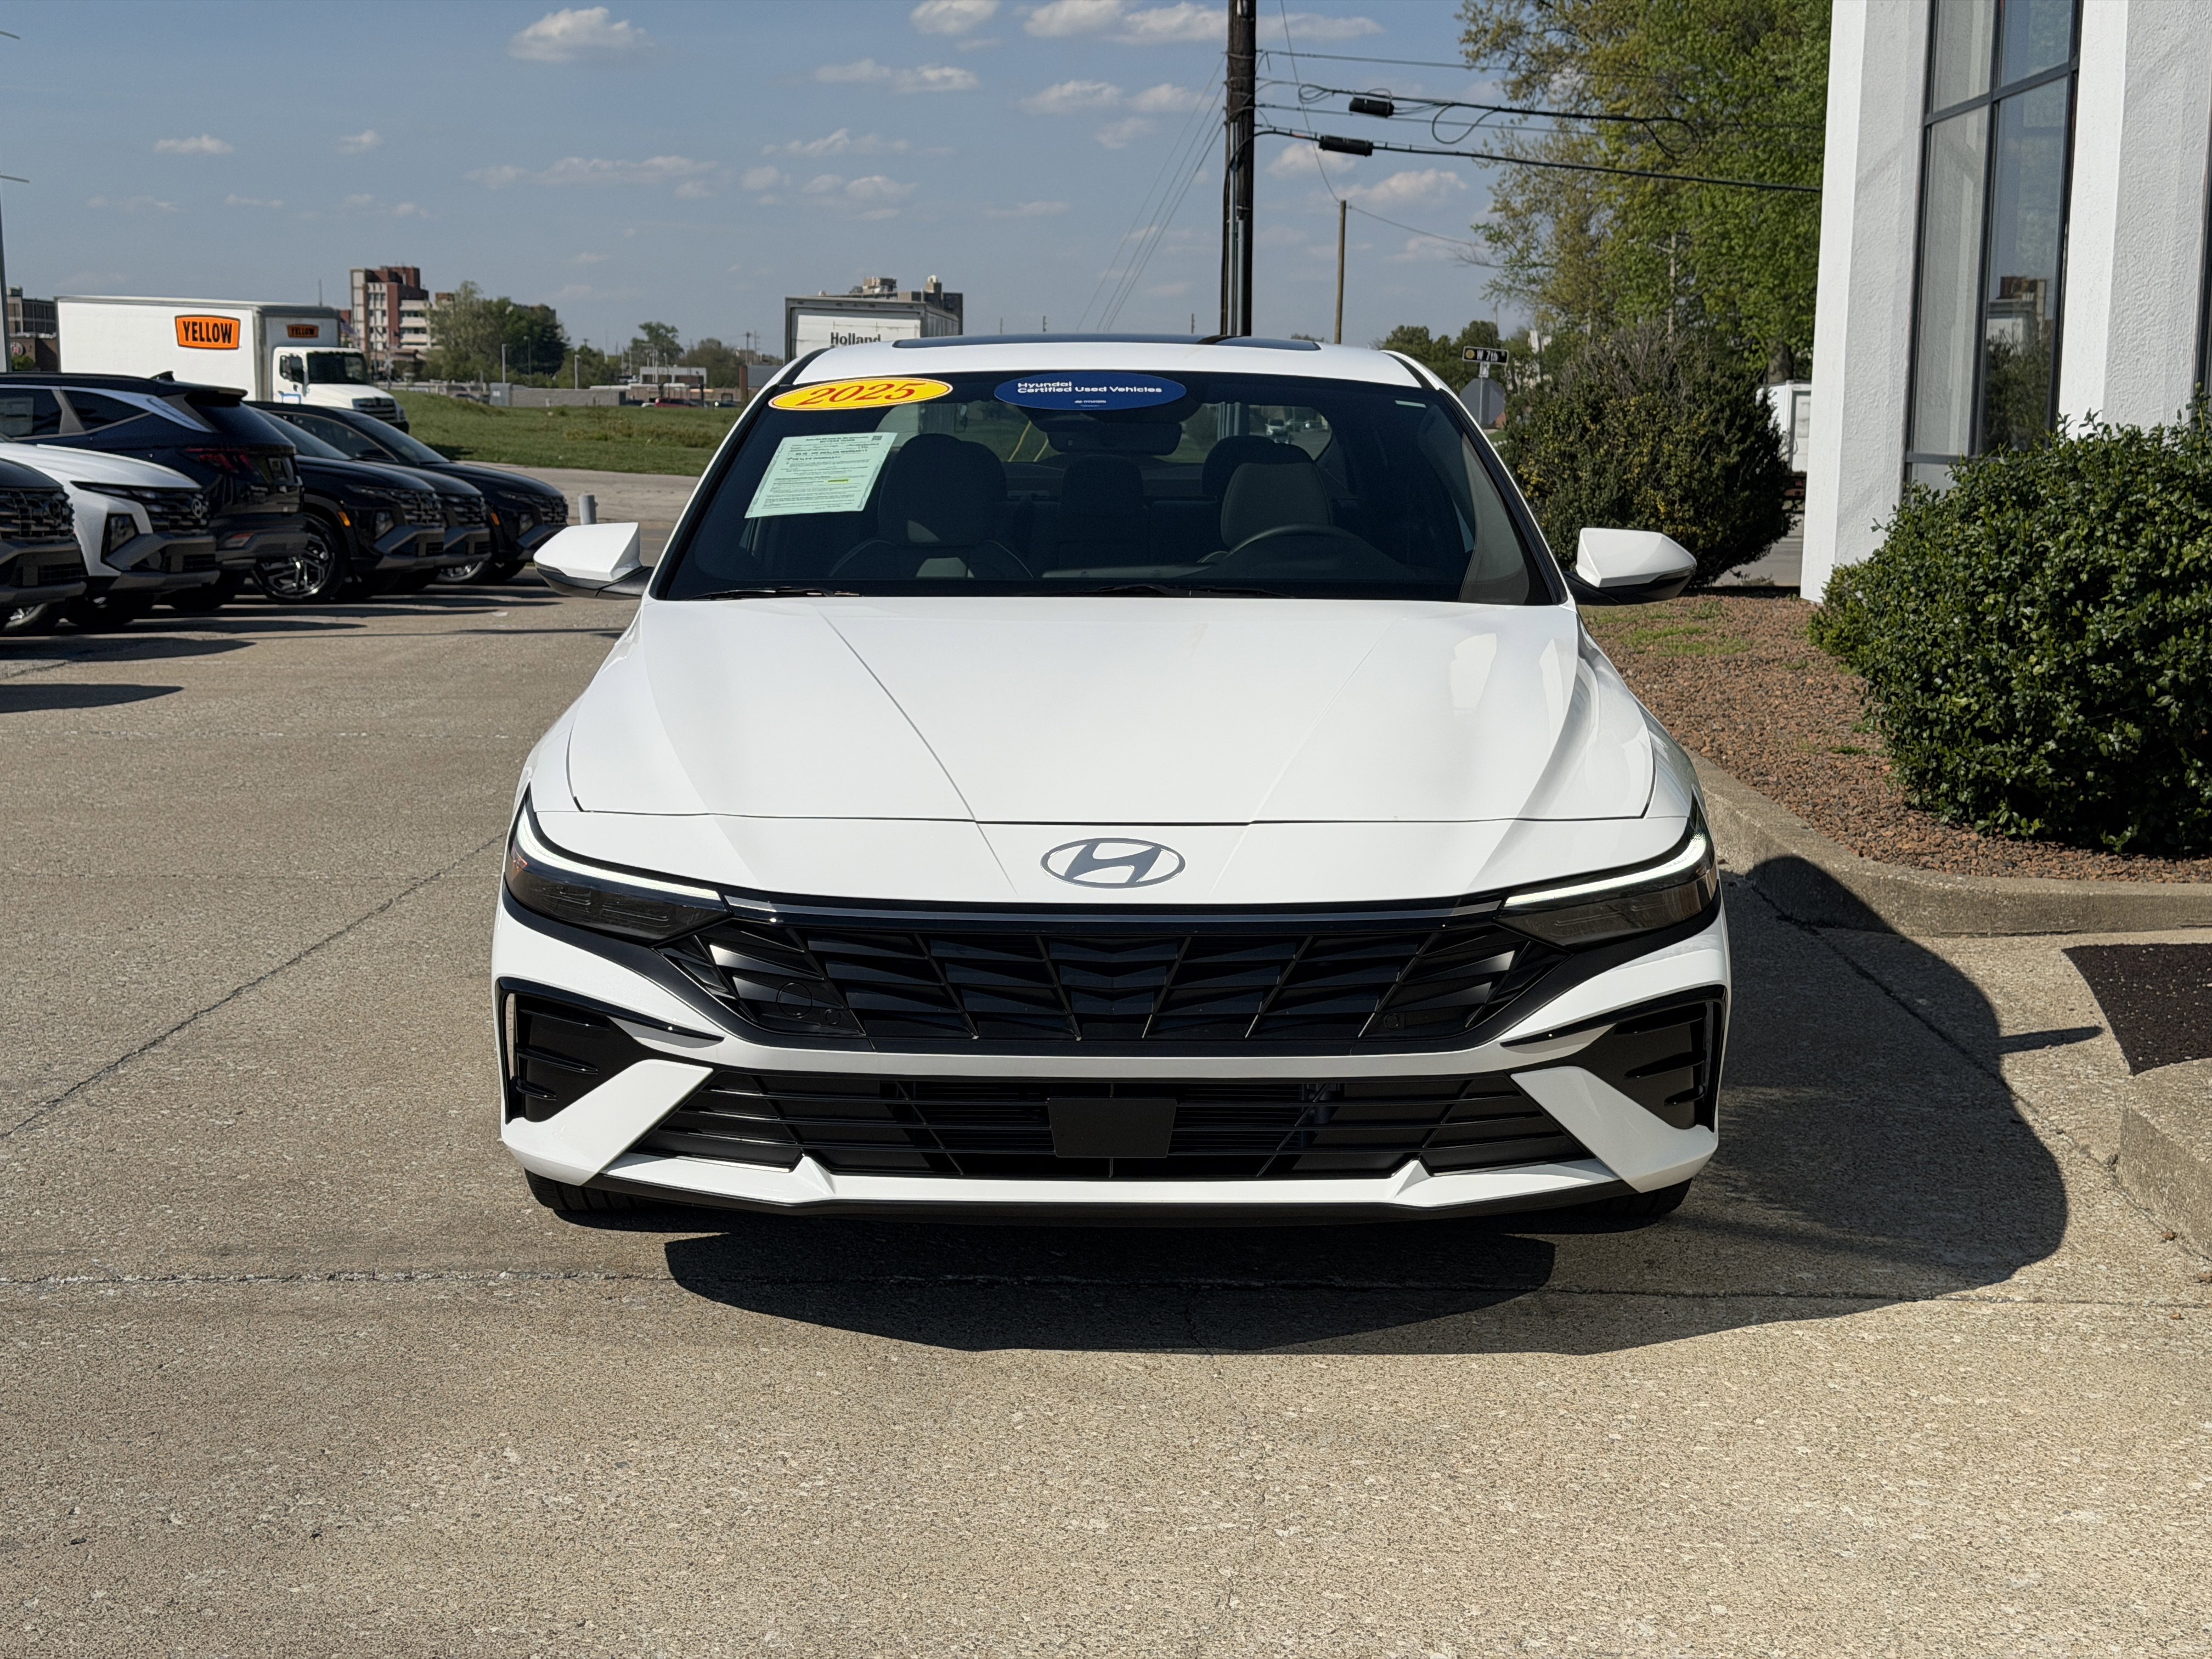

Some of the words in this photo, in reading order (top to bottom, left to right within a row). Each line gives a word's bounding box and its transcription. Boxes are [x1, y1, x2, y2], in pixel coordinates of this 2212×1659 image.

[183, 320, 233, 344] YELLOW
[831, 332, 881, 345] Holland
[1476, 349, 1484, 360] W
[1486, 350, 1499, 362] 7th
[795, 383, 926, 406] 2025
